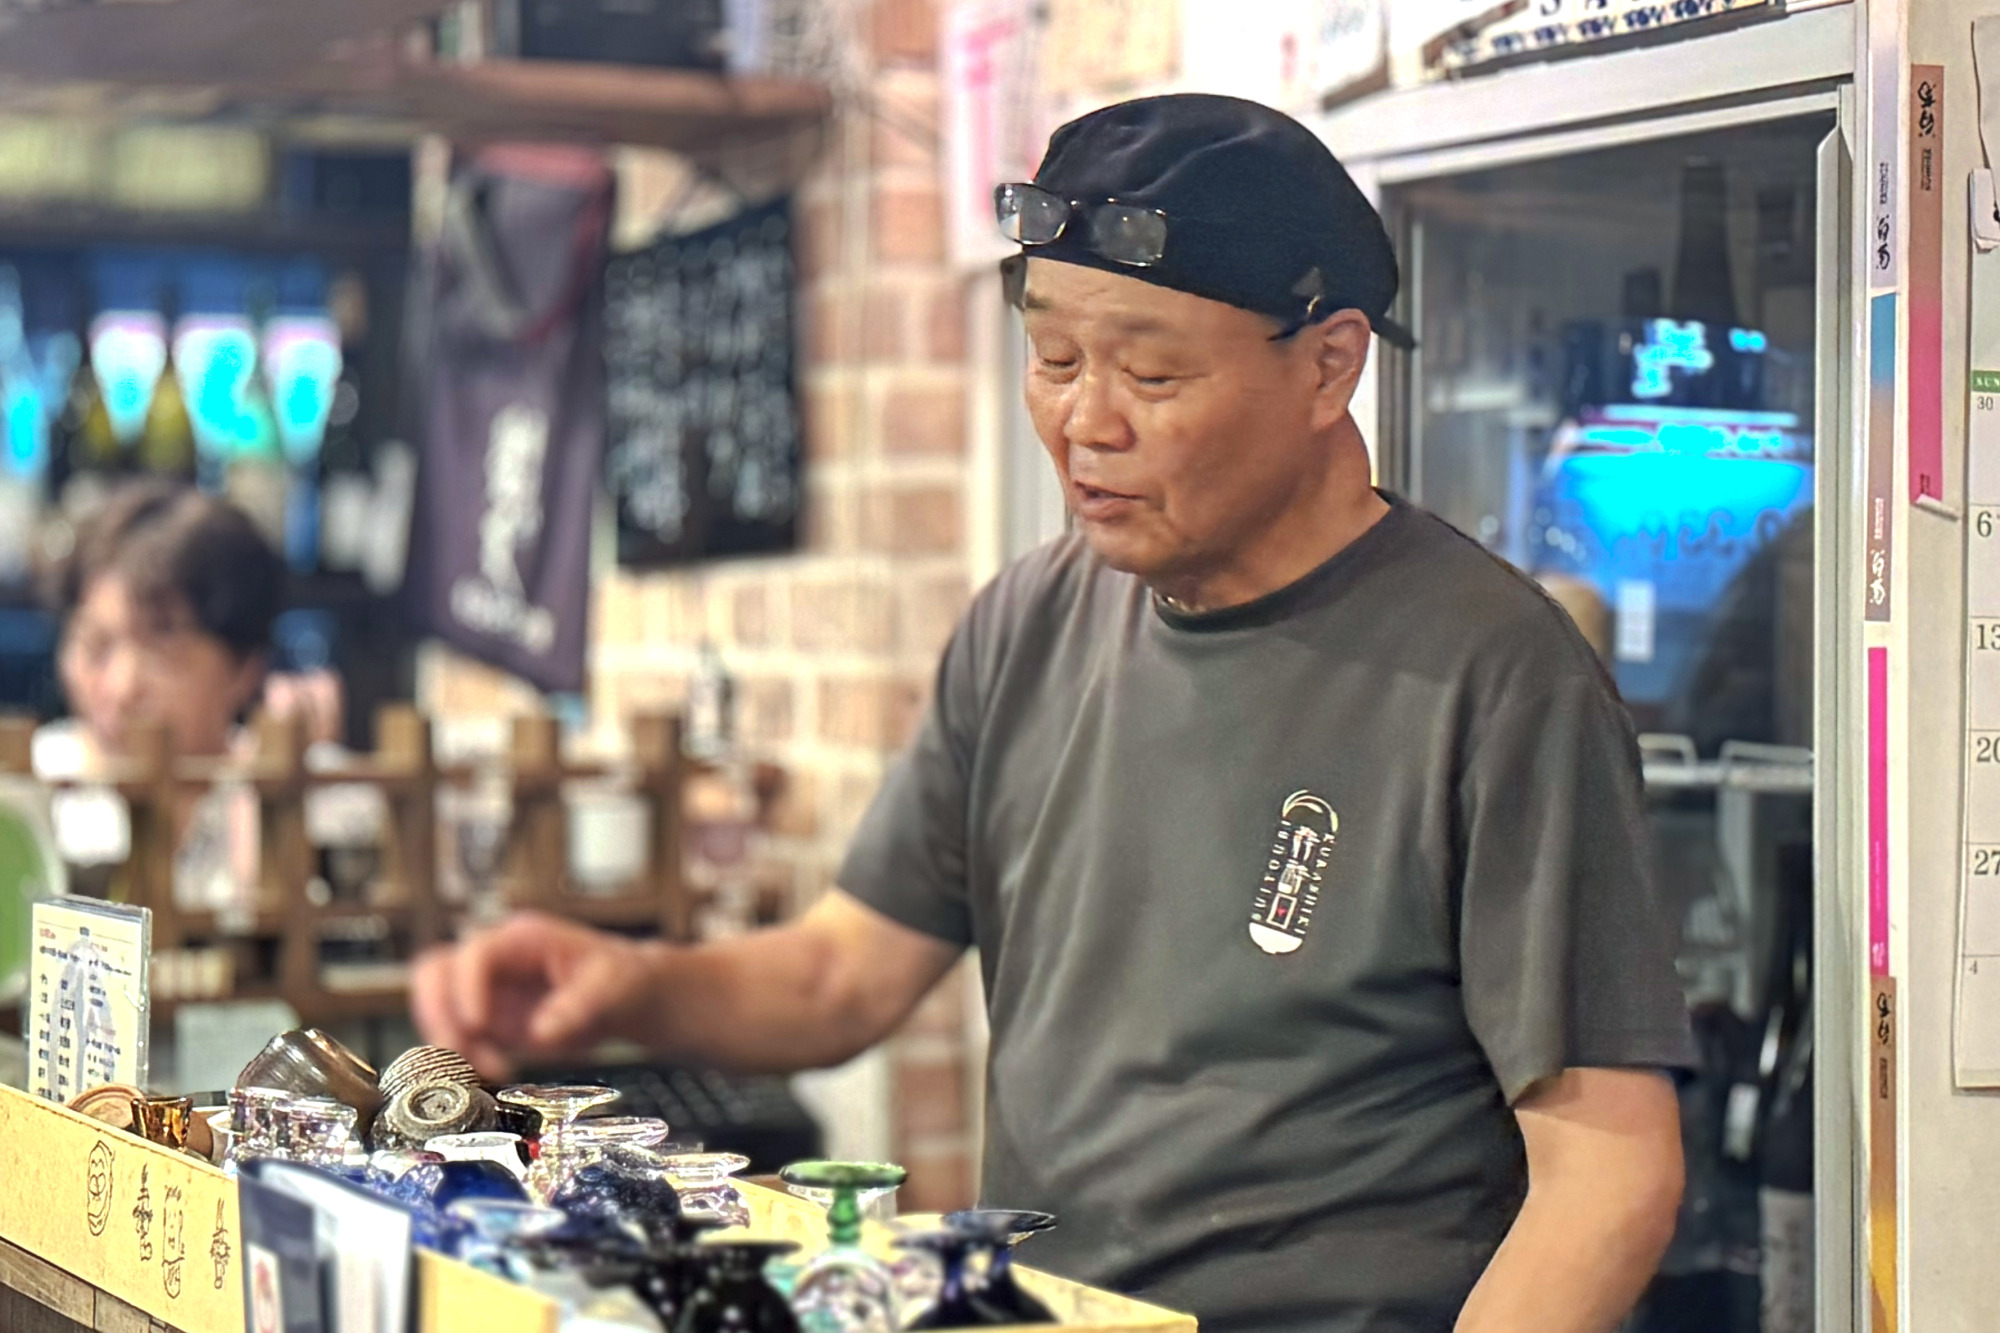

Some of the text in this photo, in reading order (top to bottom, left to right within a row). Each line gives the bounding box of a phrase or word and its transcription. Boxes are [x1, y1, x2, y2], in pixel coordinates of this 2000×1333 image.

[1977, 396, 1994, 411] 30
[1977, 511, 1992, 538] 6
[1976, 623, 2000, 650] 13
[1968, 960, 1979, 975] 4
